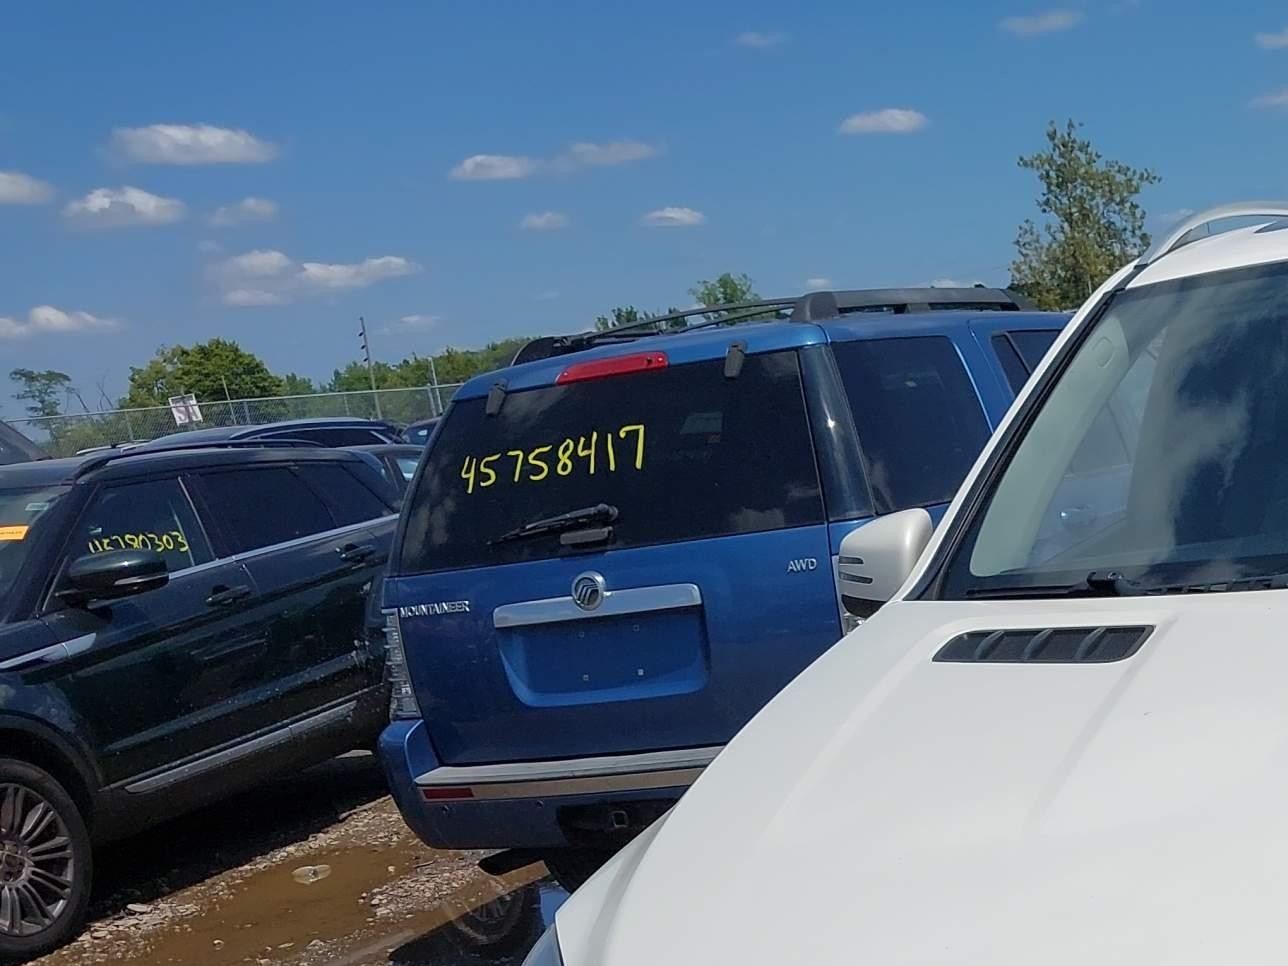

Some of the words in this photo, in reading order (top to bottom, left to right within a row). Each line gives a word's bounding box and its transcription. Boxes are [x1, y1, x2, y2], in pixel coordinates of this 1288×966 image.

[461, 424, 645, 494] 45758417
[787, 558, 817, 572] AWD
[400, 600, 470, 618] MOUNTAINEER
